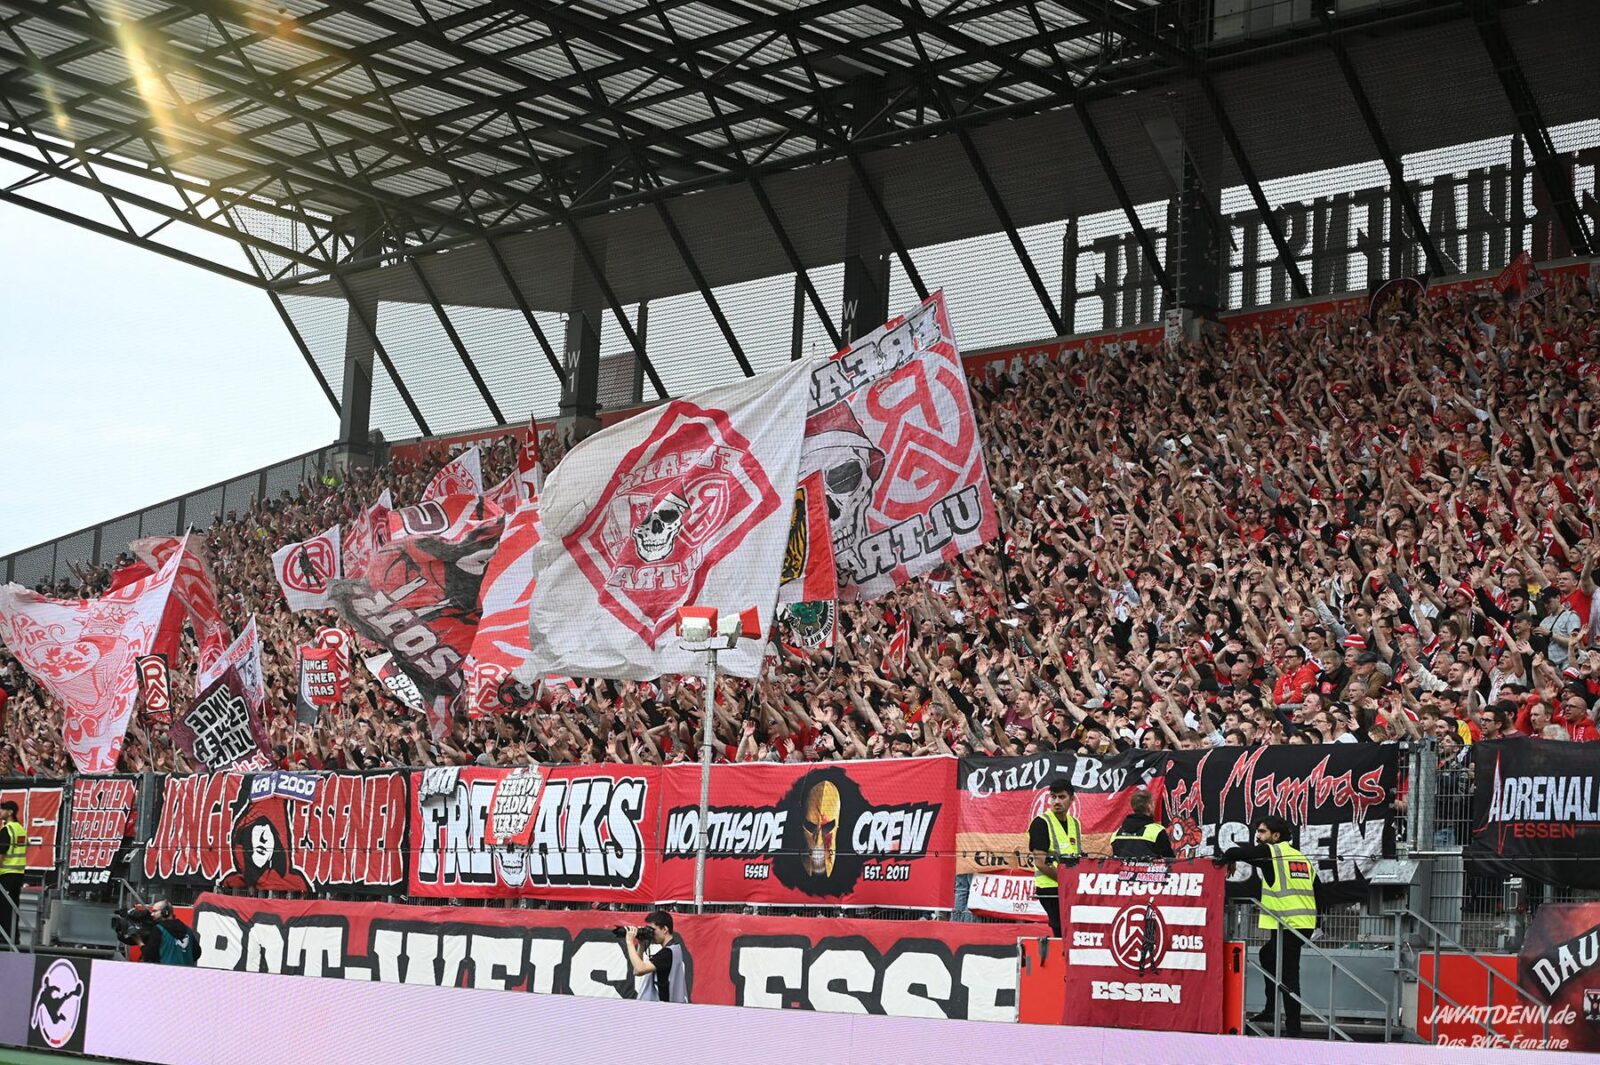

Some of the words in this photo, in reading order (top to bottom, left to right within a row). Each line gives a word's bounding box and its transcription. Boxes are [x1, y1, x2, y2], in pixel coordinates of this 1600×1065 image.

[277, 774, 316, 796] 2000
[1220, 744, 1386, 827] Mambas
[1489, 768, 1600, 823] ADRENAL
[145, 773, 245, 881] JUNGE
[291, 773, 406, 887] ESSENER
[419, 778, 645, 888] FREAKS
[852, 808, 935, 856] CREW
[1513, 823, 1576, 839] ESSEN
[69, 839, 122, 868] ERBOT
[1197, 819, 1385, 884] ESEN
[744, 864, 769, 879] ESSEN
[864, 865, 883, 880] EST.
[885, 865, 910, 880] 2011
[981, 876, 999, 897] LA
[1003, 879, 1037, 901] BAN
[1076, 872, 1205, 897] KATEGORIE
[197, 910, 662, 1000] ROT-WEIS
[1072, 931, 1105, 947] SEIT
[1171, 934, 1204, 950] 2015
[738, 946, 1018, 1022] ESSE
[1091, 980, 1182, 1005] ESSEN
